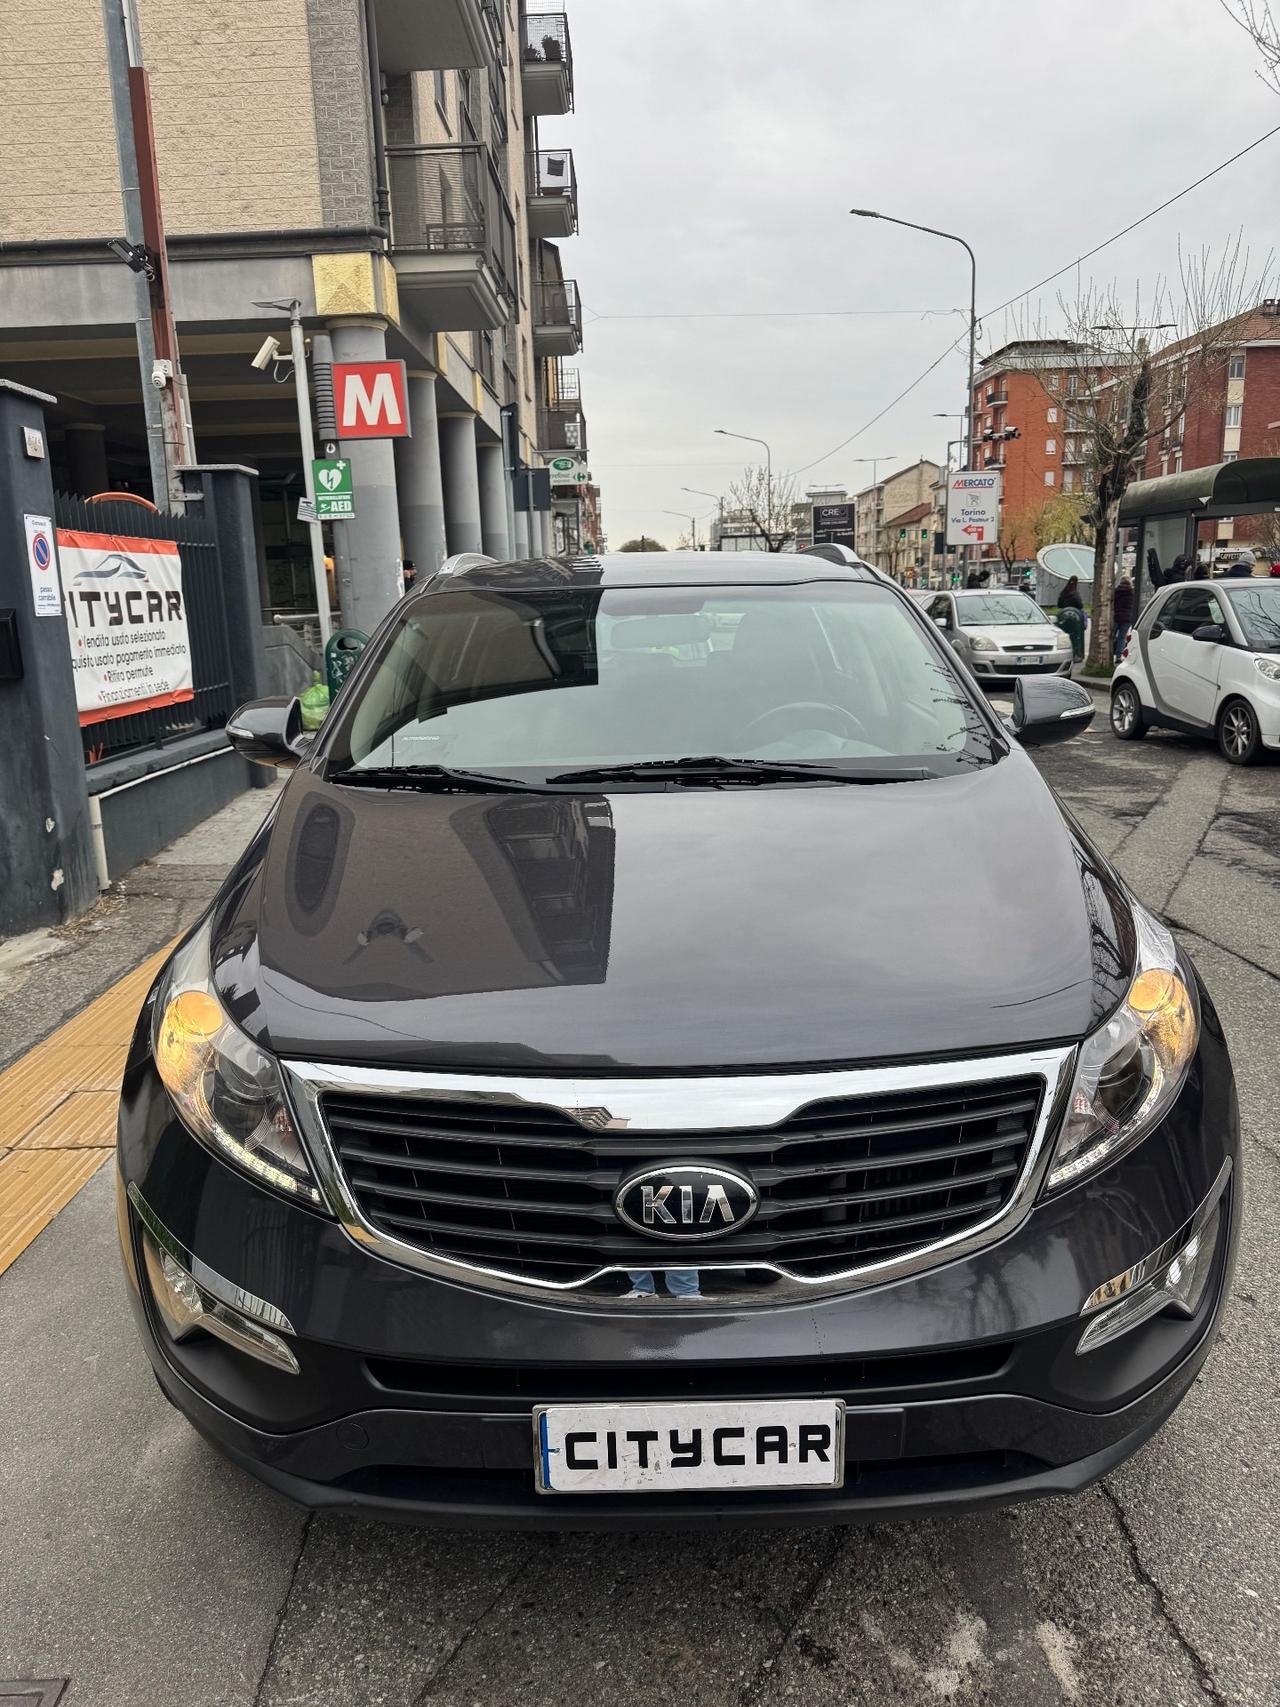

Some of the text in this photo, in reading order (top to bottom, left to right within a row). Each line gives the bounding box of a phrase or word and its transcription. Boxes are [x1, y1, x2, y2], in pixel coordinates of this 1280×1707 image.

[342, 373, 402, 427] M
[953, 478, 995, 488] MERCATO
[331, 500, 352, 512] AED
[961, 507, 986, 516] Torino
[64, 591, 183, 628] ITYCAR
[111, 631, 129, 646] usato
[130, 628, 166, 643] selezionato
[72, 642, 186, 672] quisto usato pagamento immediato
[107, 665, 153, 683] Ritiro permute
[101, 682, 146, 703] Finanziamenti
[154, 679, 169, 692] sede
[641, 1185, 735, 1224] KIA
[565, 1424, 831, 1470] CITYCAR
